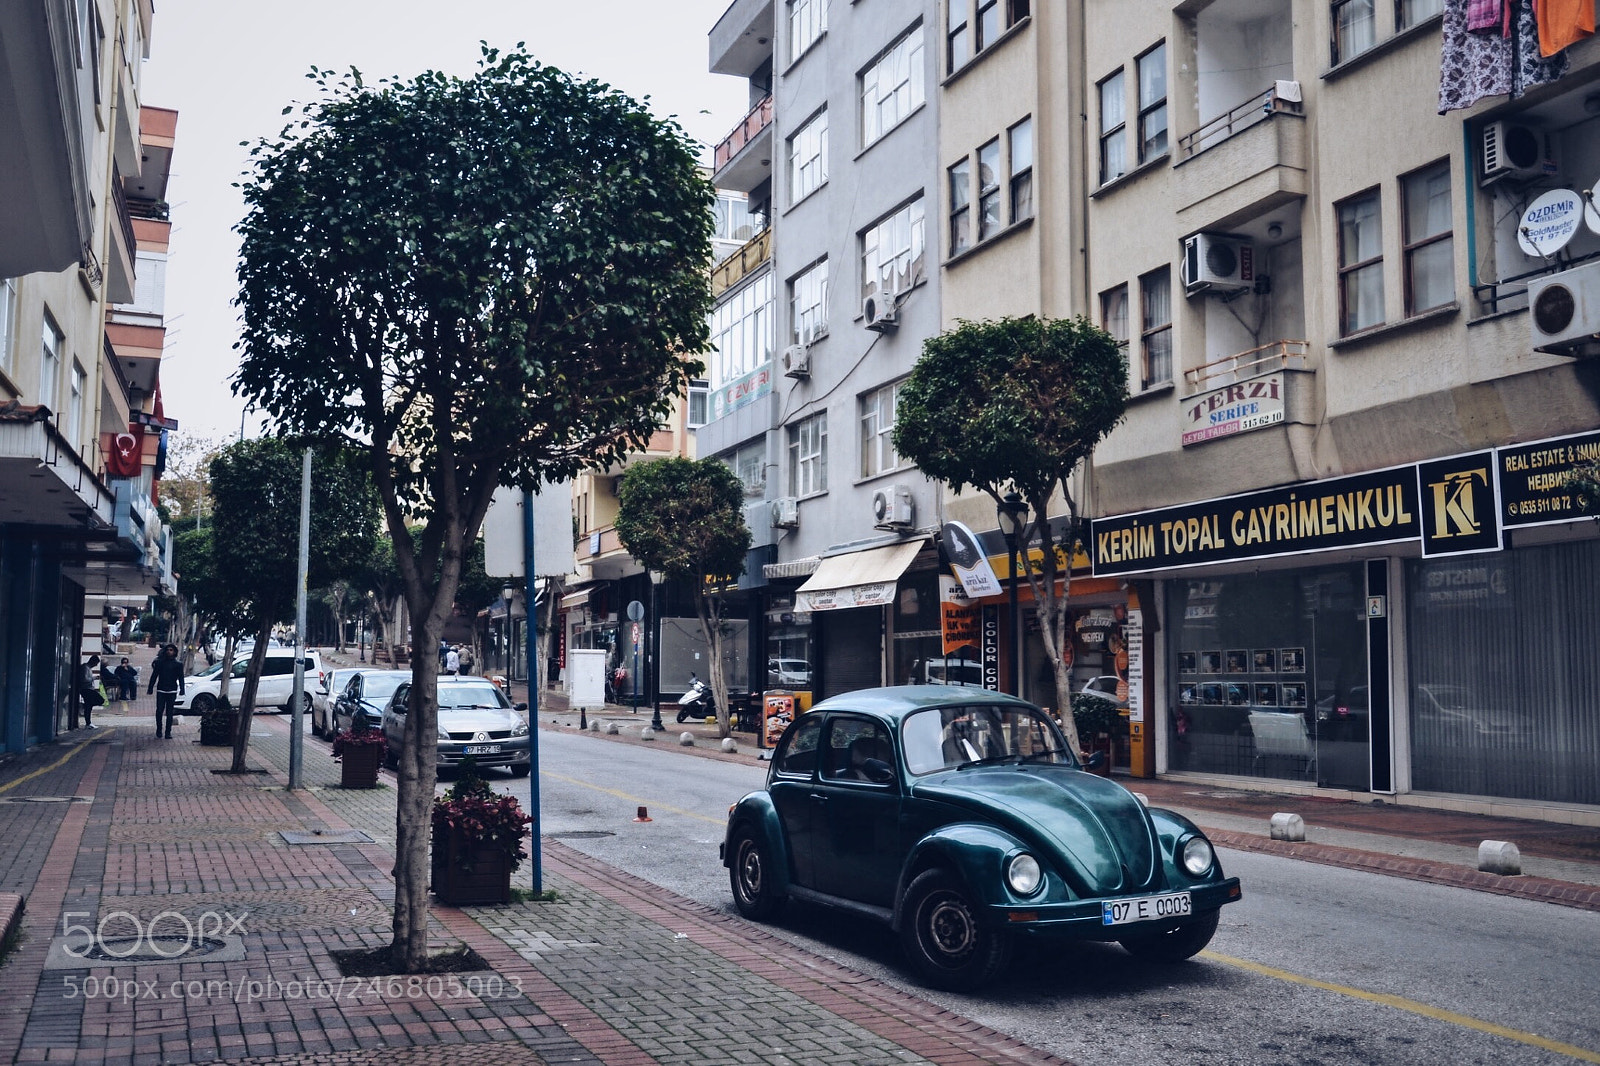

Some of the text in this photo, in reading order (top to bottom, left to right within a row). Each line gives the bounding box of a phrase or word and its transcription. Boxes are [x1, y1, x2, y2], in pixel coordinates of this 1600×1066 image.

[1188, 379, 1280, 423] TERZİ
[1208, 422, 1239, 437] TAILOR
[1259, 415, 1269, 425] 62
[1272, 412, 1282, 422] 10
[1505, 454, 1529, 472] REAL
[1530, 448, 1565, 468] ESTATE
[1567, 445, 1574, 463] &
[1519, 500, 1537, 515] 0535
[1537, 498, 1550, 513] 511
[1562, 495, 1571, 510] 72
[1098, 484, 1412, 564] KERİM TOPAL GAYRİMENKUL
[985, 621, 997, 662] COLOR
[1112, 895, 1189, 921] 07 E 0003
